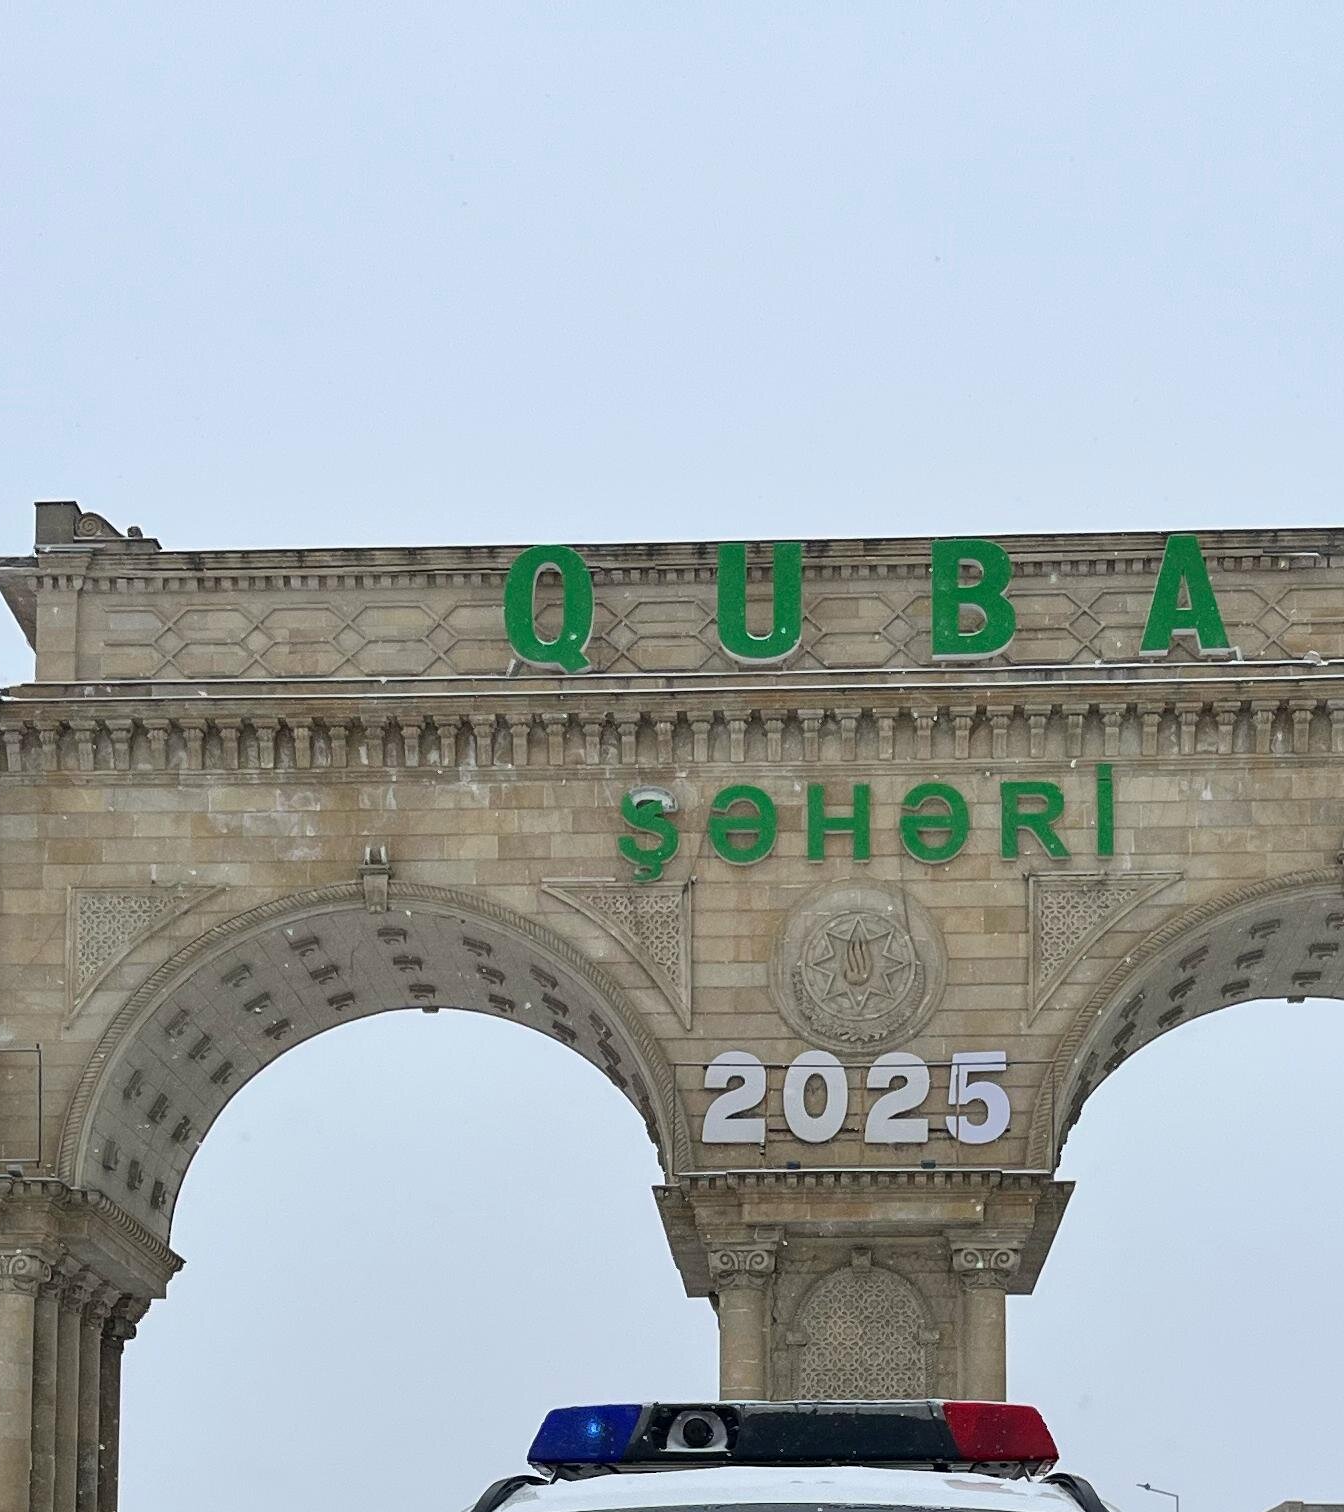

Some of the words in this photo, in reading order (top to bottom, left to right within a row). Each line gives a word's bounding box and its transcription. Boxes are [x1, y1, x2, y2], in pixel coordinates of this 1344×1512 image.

[503, 534, 1233, 673] QUBA
[617, 763, 1114, 882] ŞƏHƏRİ
[702, 1050, 1011, 1144] 2025
